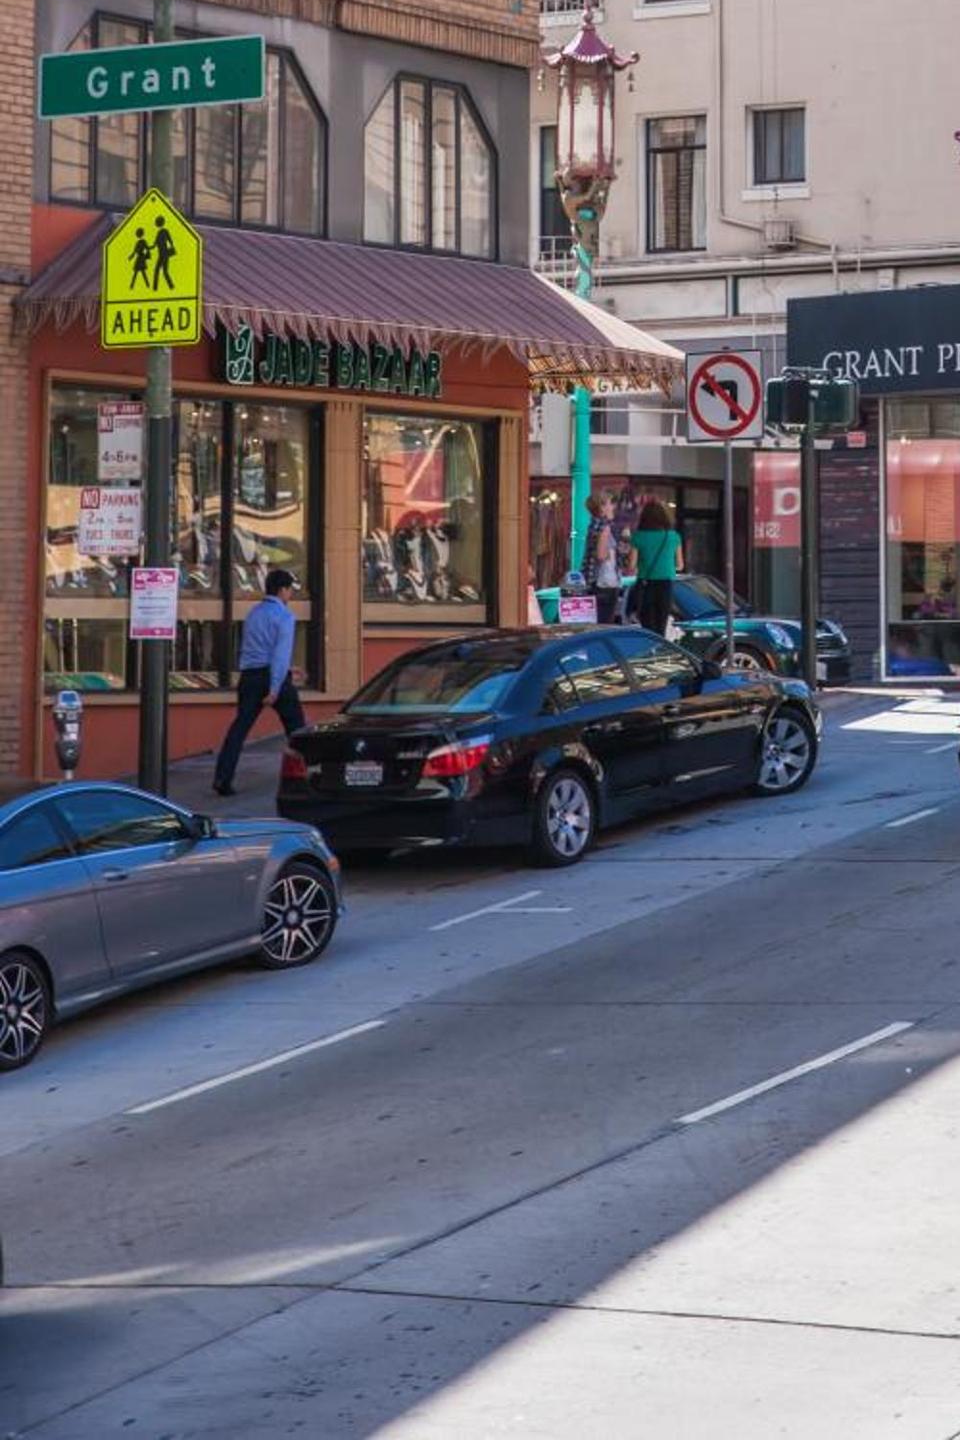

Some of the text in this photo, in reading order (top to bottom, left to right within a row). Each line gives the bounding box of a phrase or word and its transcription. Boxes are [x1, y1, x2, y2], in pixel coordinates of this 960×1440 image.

[87, 56, 216, 99] Grant
[112, 307, 191, 334] AHEAD
[259, 333, 443, 398] JADE BAZAAR
[823, 347, 924, 380] GRANT
[83, 489, 140, 507] NO PARKING
